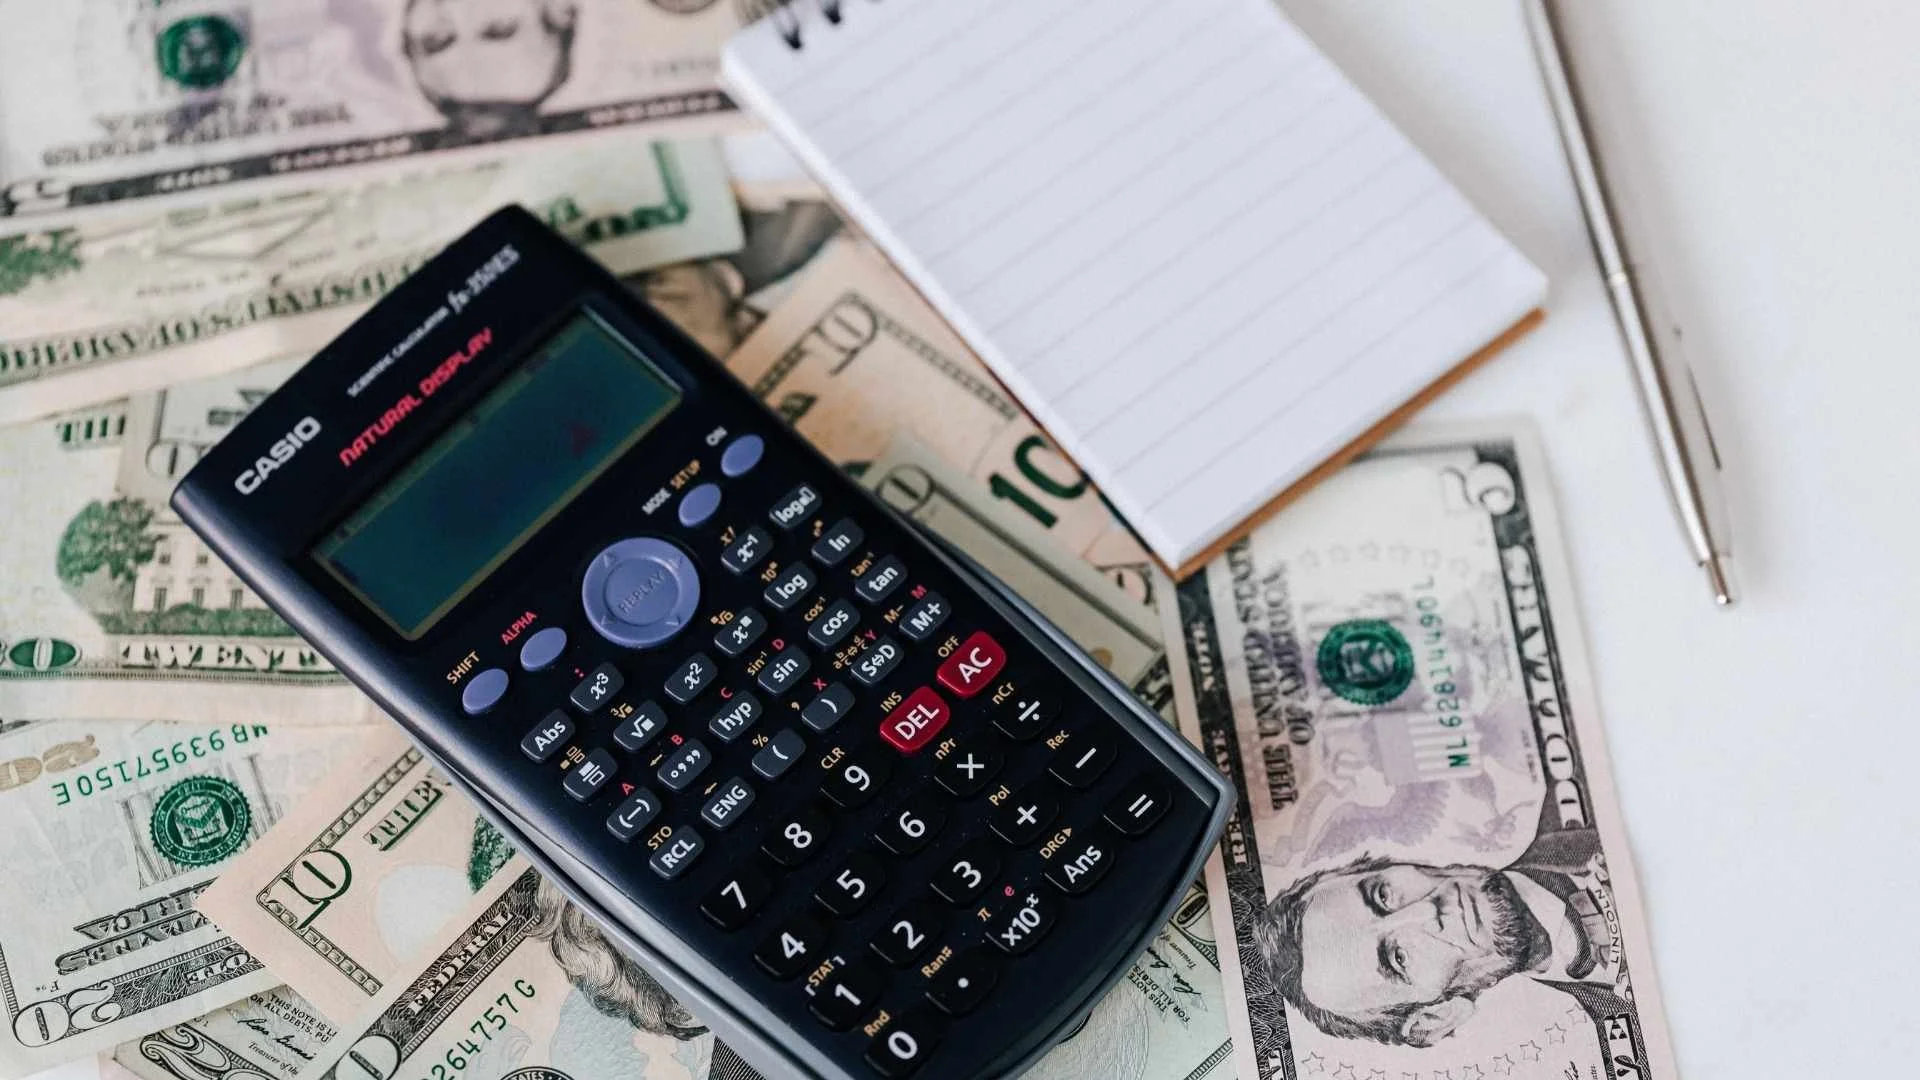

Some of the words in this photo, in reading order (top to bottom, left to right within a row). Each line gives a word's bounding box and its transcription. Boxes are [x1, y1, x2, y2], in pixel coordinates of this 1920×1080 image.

[339, 393, 421, 467] NATURAL
[419, 327, 494, 397] DISPLAY
[705, 425, 728, 447] ON
[234, 416, 322, 496] CASIO
[641, 487, 672, 515] MODE
[775, 572, 809, 602] log
[868, 566, 899, 593] tan
[910, 584, 928, 600] M
[500, 610, 538, 646] ALPHA
[821, 609, 850, 637] cos
[910, 600, 943, 633] M+
[771, 638, 785, 651] D
[937, 634, 960, 658] OFF
[446, 650, 481, 685] SHIFT
[771, 657, 799, 683] sin
[957, 646, 993, 684] AC
[991, 681, 1016, 706] nCr
[1243, 628, 1286, 742] UNITED
[879, 690, 903, 713] INS
[717, 702, 752, 731] hyp
[894, 703, 940, 742] DEL
[533, 720, 568, 752] Abs
[671, 733, 685, 747] B
[934, 737, 958, 761] nPr
[1046, 728, 1071, 751] Rec
[820, 746, 846, 771] CLR
[844, 764, 871, 792] 9
[1263, 743, 1300, 812] THE
[711, 784, 748, 821] ENG
[988, 785, 1012, 807] Pol
[647, 825, 673, 851] STO
[784, 821, 813, 850] 8
[899, 811, 926, 839] 6
[660, 838, 697, 870] RCL
[1062, 845, 1103, 884] Ans
[836, 868, 866, 900] 5
[952, 860, 983, 890] 3
[720, 880, 748, 911] 7
[891, 920, 926, 951] 2
[1594, 889, 1622, 965] LINCOLN
[780, 931, 808, 960] 4
[405, 905, 516, 1017] FEDERAL
[263, 1001, 282, 1017] ALL
[269, 993, 291, 1011] THIS
[290, 1006, 318, 1026] NOTE
[834, 982, 862, 1008] 1
[1148, 993, 1168, 1014] THIS
[12, 978, 122, 1048] 20
[863, 1009, 892, 1038] Rnd
[886, 1029, 919, 1061] 0
